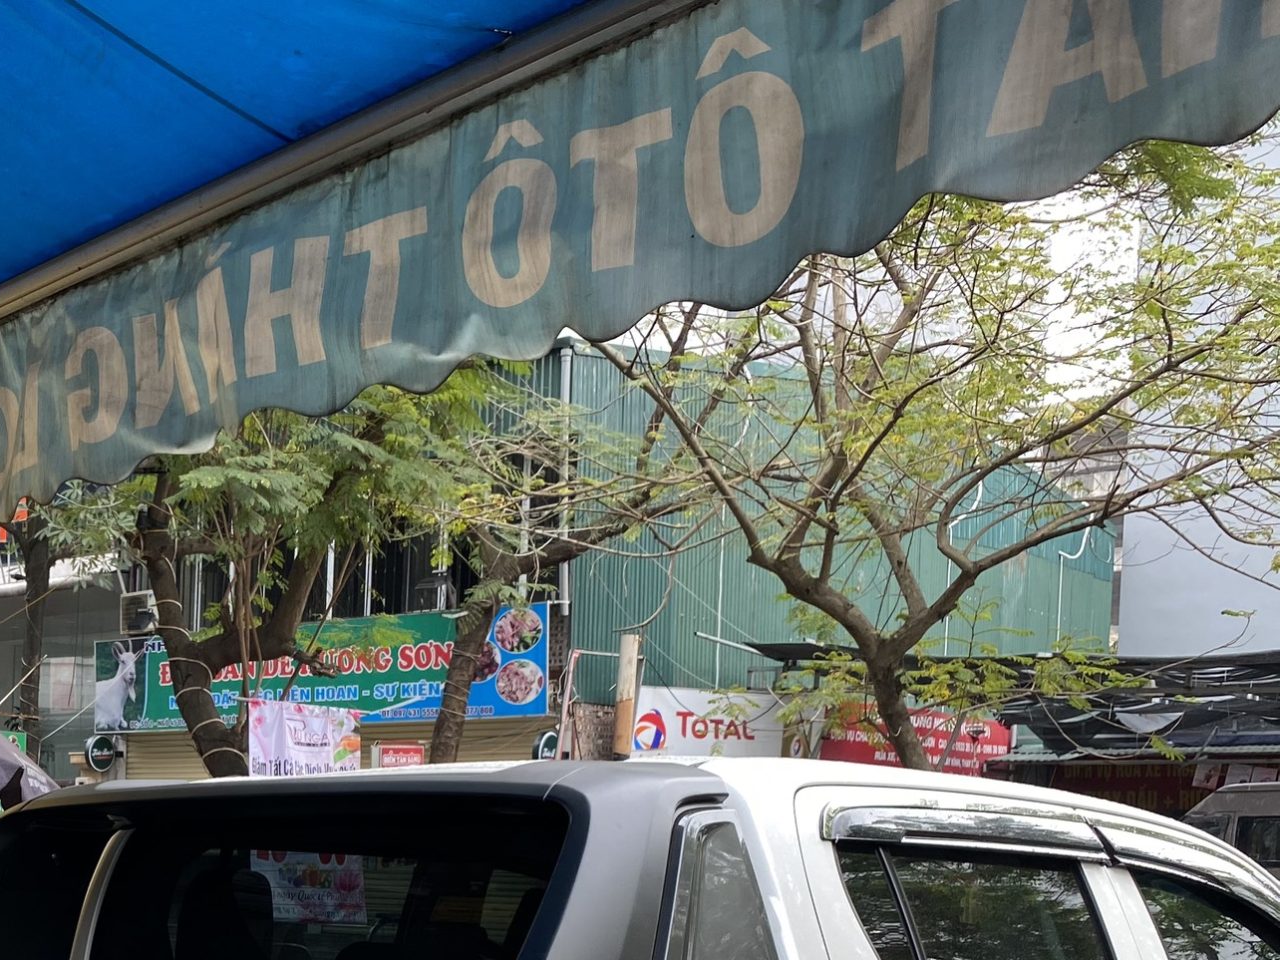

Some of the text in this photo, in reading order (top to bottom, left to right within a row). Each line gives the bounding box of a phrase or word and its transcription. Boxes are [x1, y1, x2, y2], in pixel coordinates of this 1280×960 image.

[398, 640, 454, 670] SƠN
[314, 685, 359, 702] HOAN
[374, 682, 399, 702] SỰ
[401, 680, 442, 701] KIỆN
[675, 711, 756, 741] TOTAL
